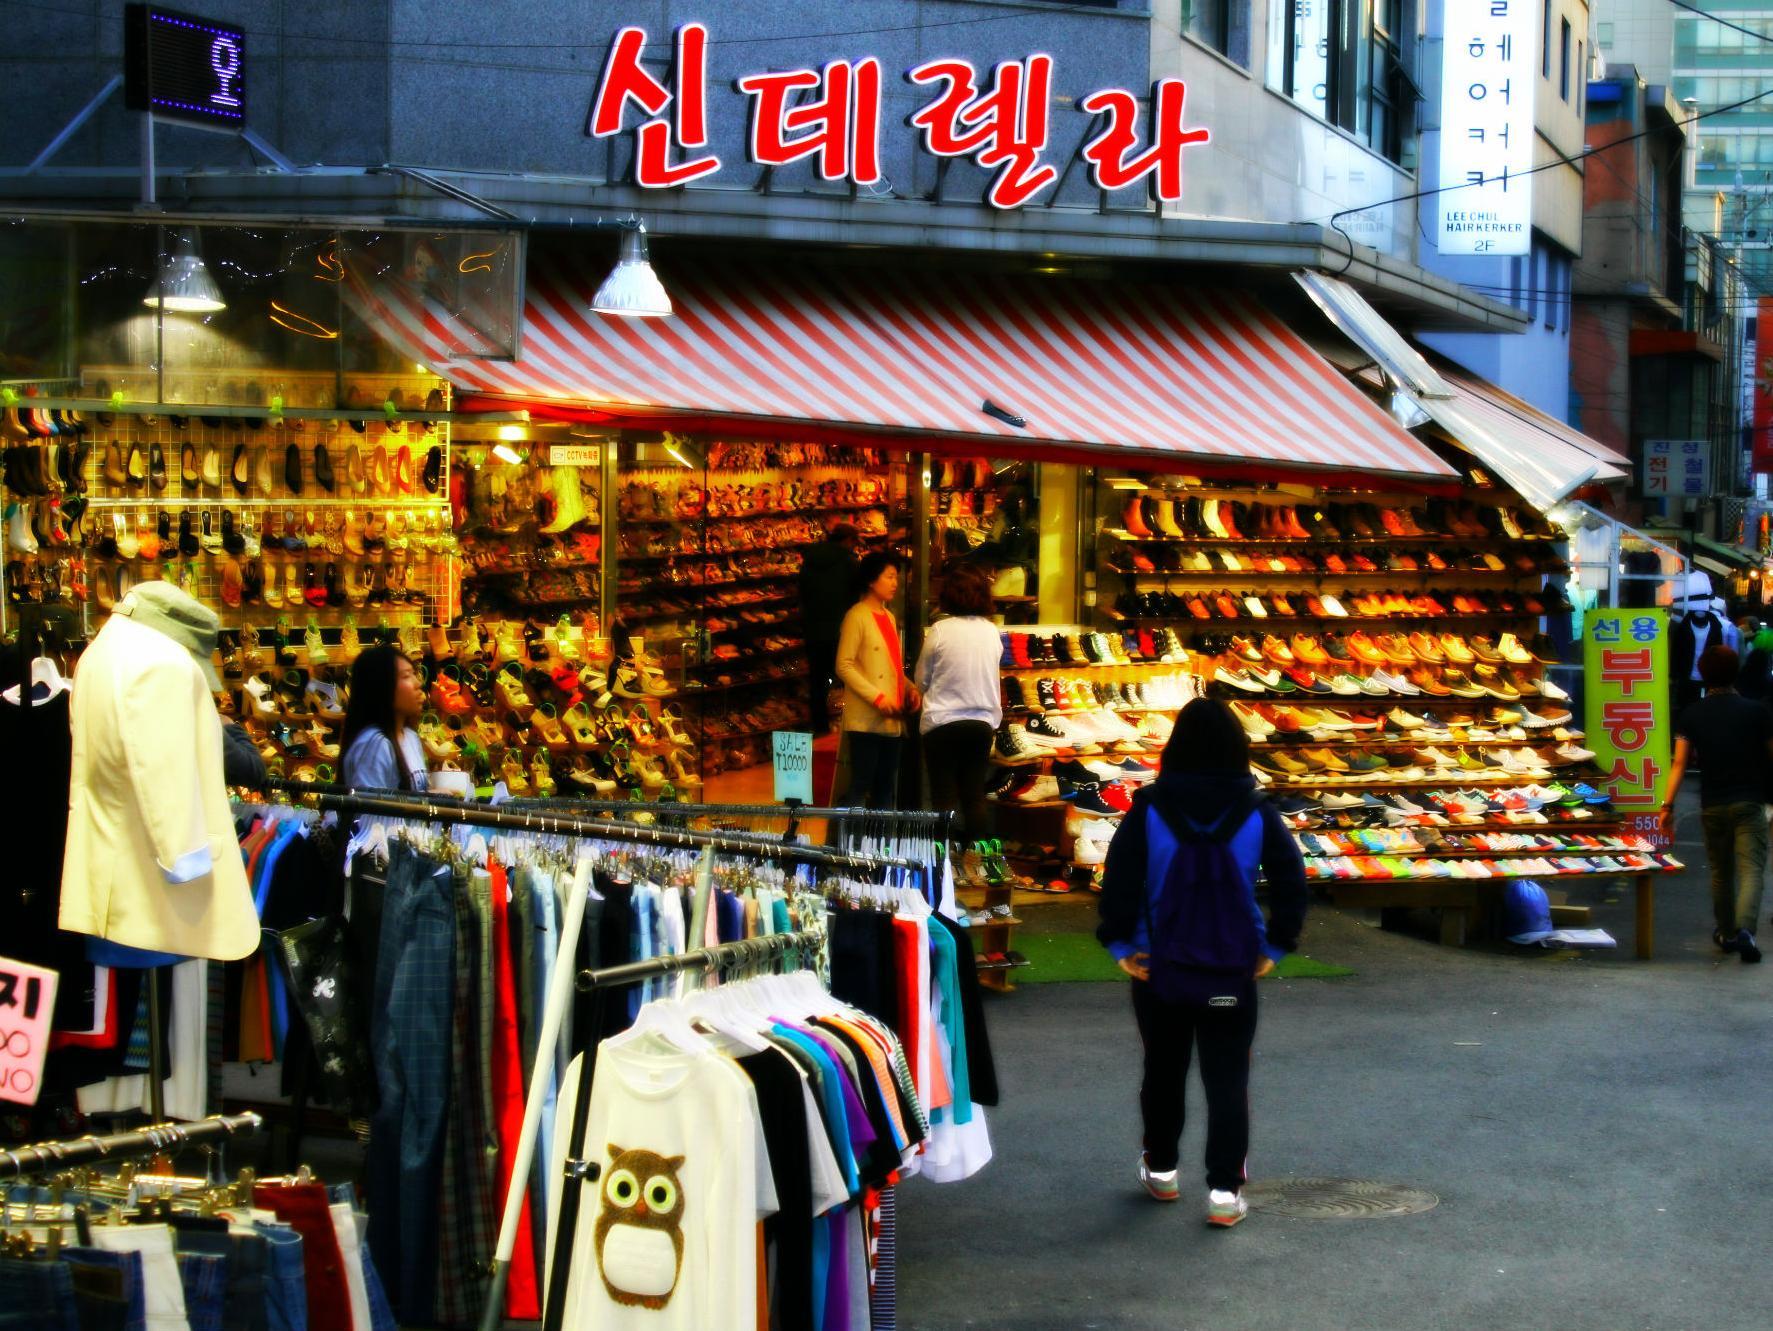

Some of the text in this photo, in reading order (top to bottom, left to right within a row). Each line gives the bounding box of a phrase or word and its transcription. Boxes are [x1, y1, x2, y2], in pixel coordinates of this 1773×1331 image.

[590, 23, 1210, 210] 신데렐라
[1447, 211, 1467, 222] LEE
[1474, 239, 1497, 252] 2F
[1600, 648, 1661, 805] 부동산
